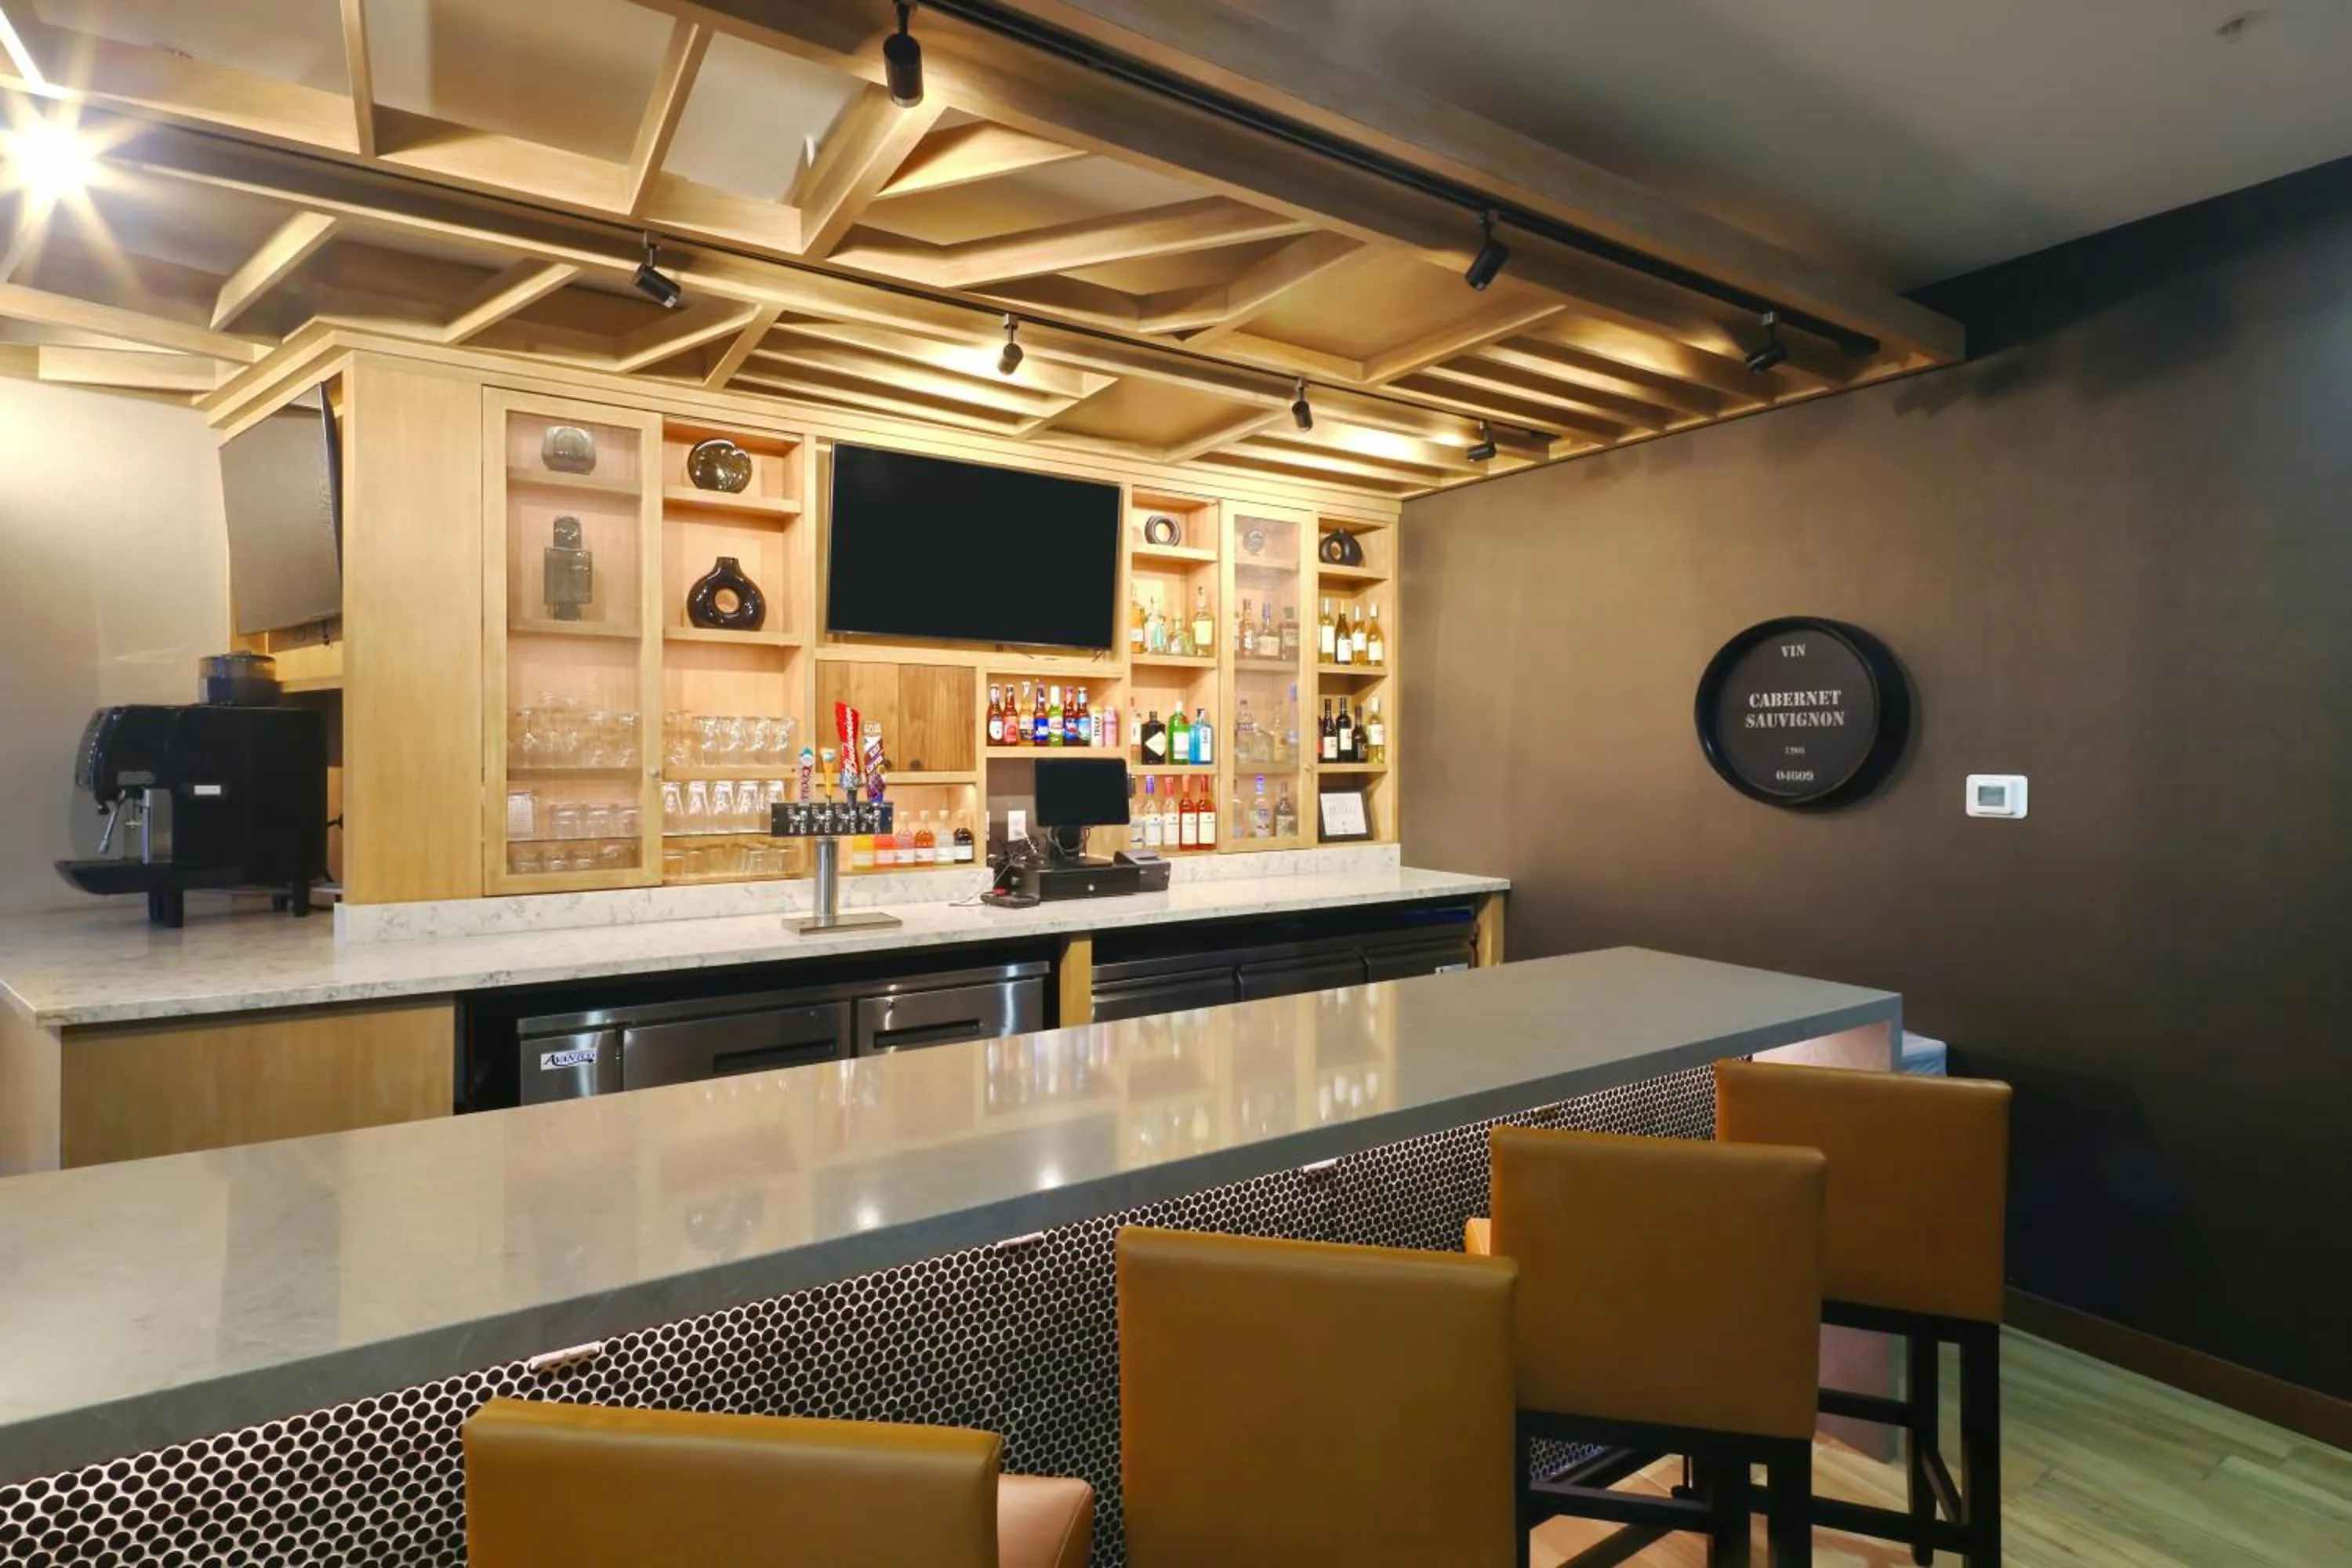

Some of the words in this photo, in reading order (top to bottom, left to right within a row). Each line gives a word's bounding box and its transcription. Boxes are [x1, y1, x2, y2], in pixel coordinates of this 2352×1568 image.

[1781, 644, 1806, 658] VIN
[1749, 690, 1842, 708] CABERNET
[1745, 711, 1844, 728] SAUVIGNON
[841, 706, 858, 775] Budweiser
